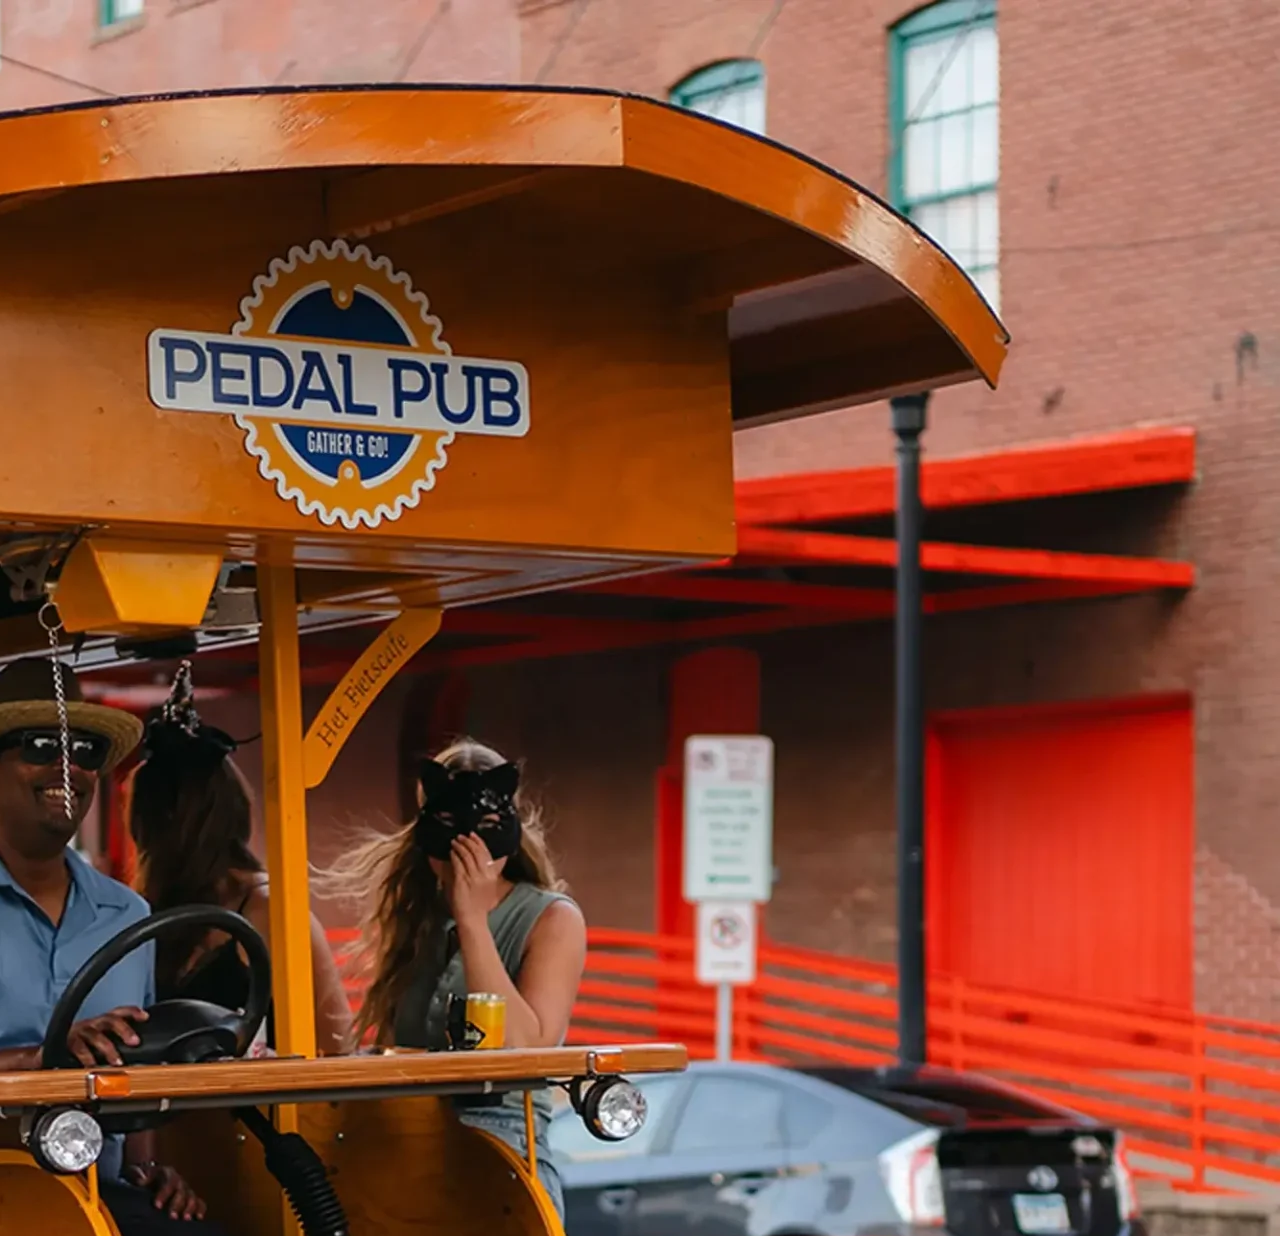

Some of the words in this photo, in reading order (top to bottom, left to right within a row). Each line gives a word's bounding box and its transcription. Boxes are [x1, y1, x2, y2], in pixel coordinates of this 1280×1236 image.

[158, 336, 378, 417] PEDAL
[387, 357, 522, 428] PUB
[306, 430, 353, 456] GATHER
[356, 434, 365, 458] &
[368, 435, 389, 459] GO!
[316, 705, 351, 748] Het
